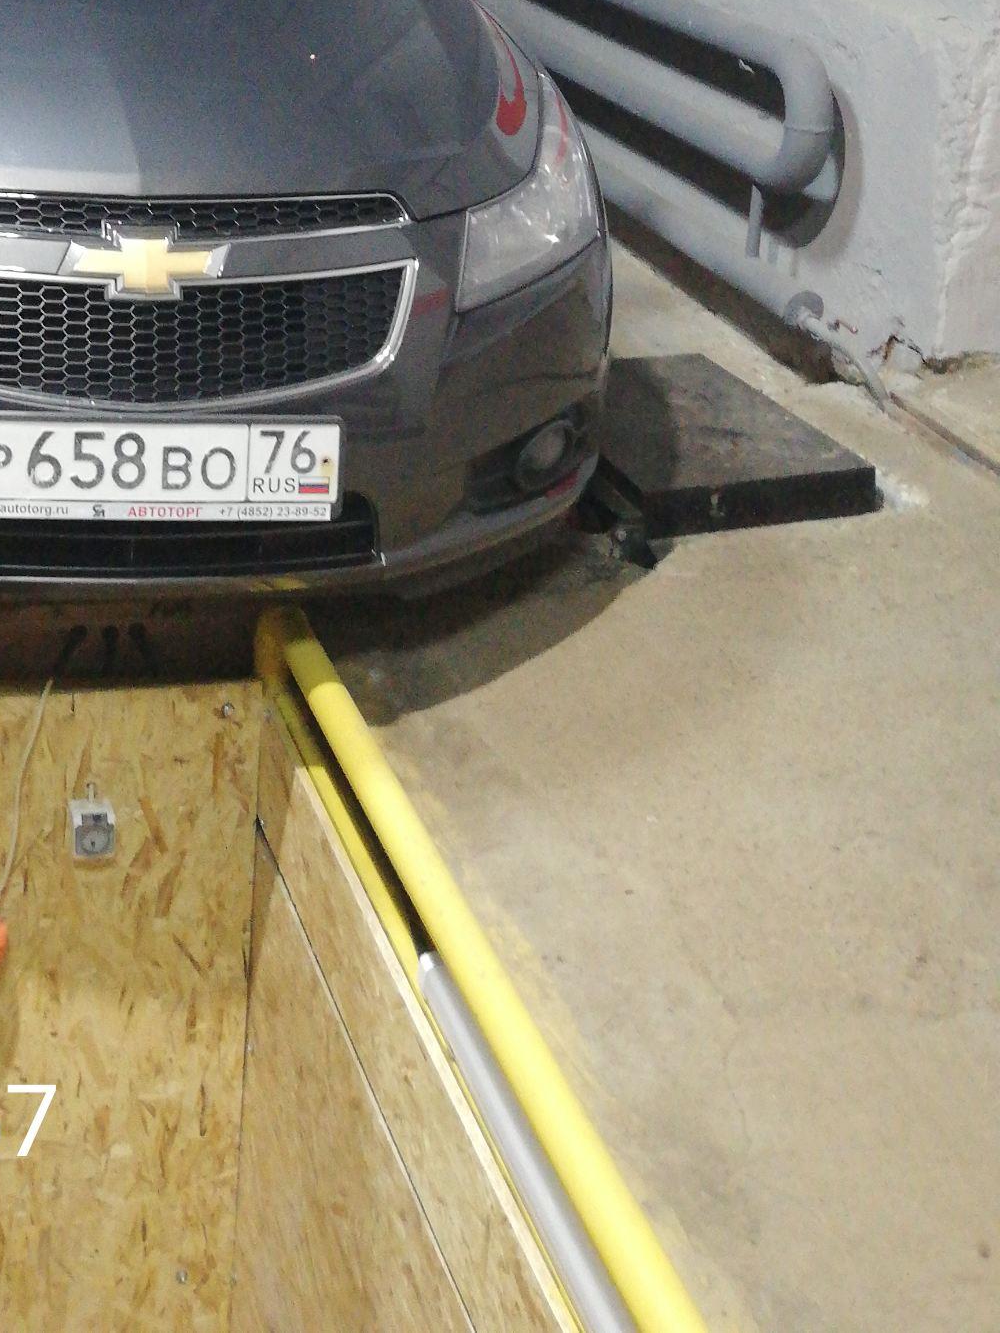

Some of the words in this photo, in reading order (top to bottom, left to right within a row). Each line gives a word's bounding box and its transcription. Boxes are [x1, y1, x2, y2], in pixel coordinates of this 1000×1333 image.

[259, 430, 318, 475] 76
[252, 478, 296, 493] RUS
[219, 505, 233, 517] +7
[237, 506, 273, 520] (4852)
